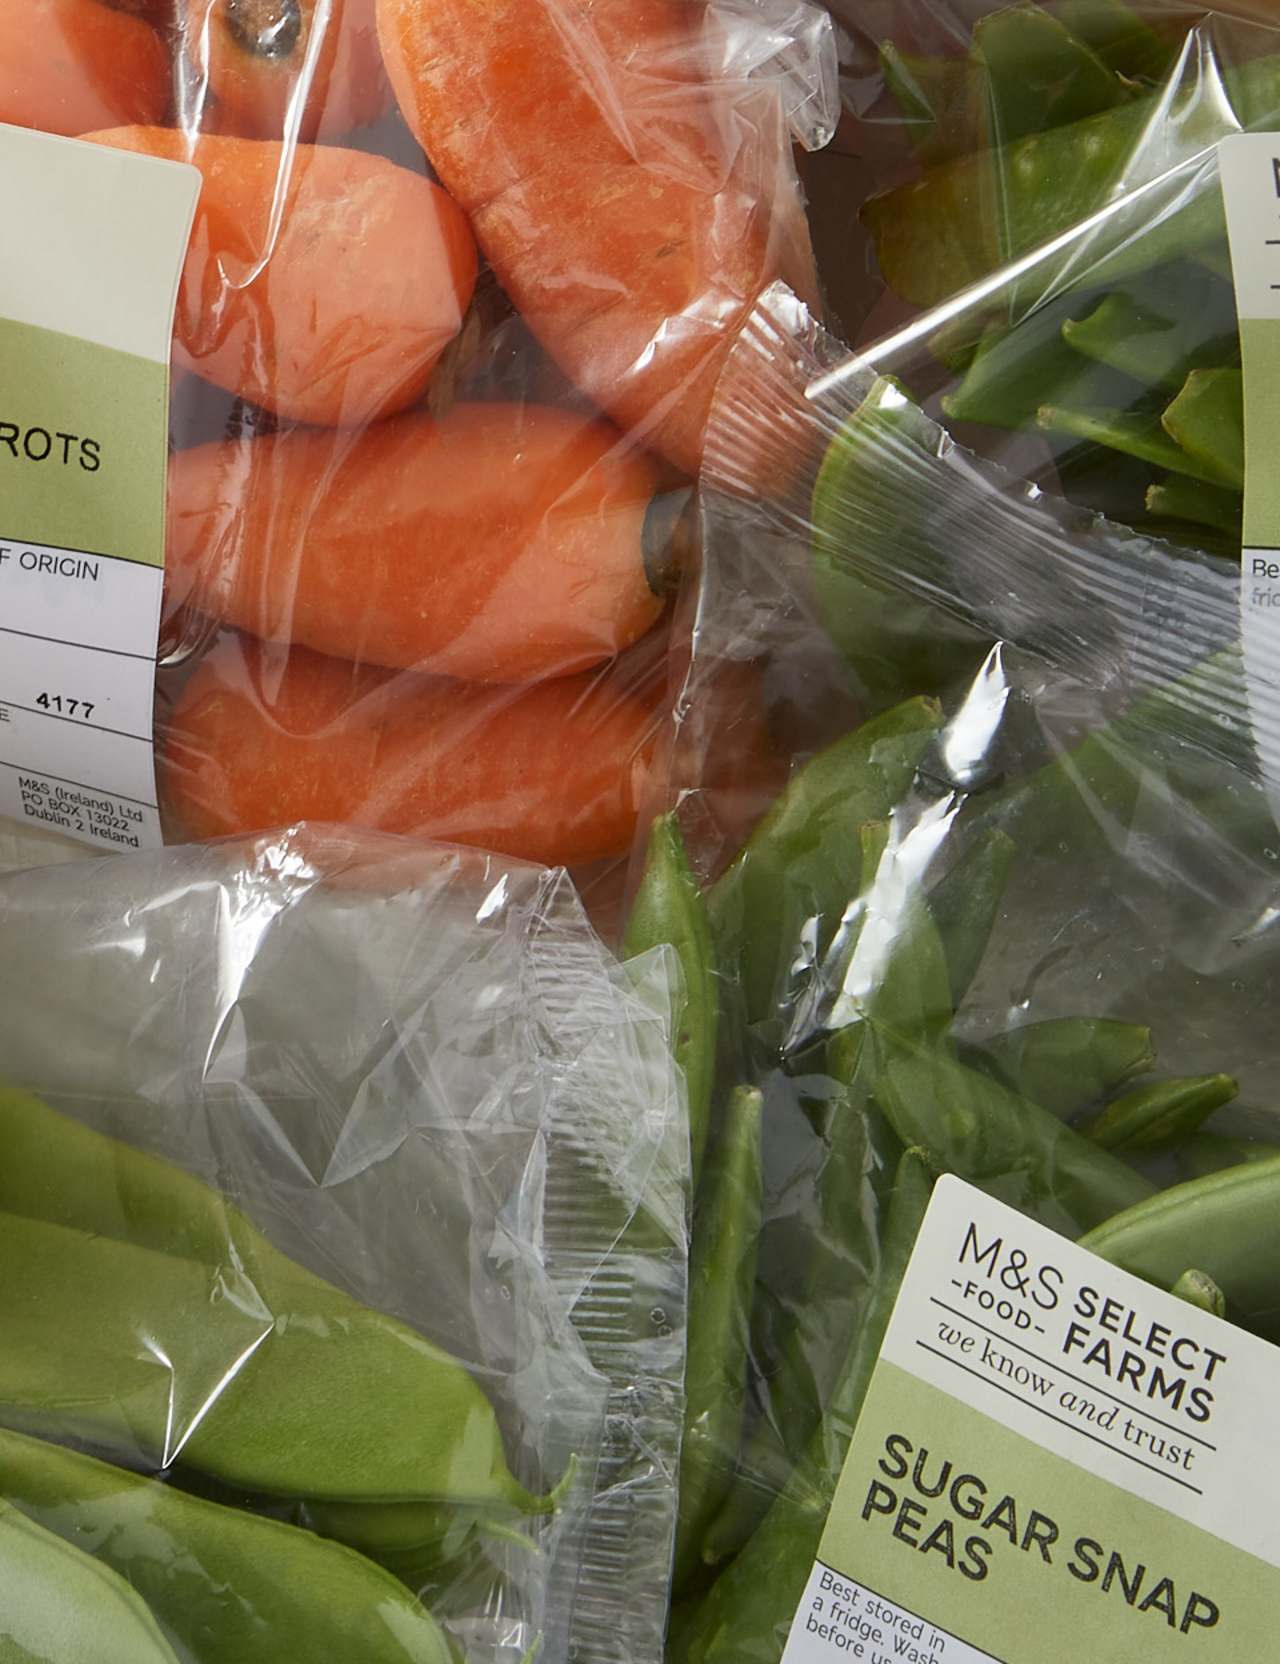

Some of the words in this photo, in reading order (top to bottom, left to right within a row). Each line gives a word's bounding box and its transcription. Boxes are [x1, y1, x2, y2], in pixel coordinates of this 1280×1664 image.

[20, 551, 100, 582] ORIGIN
[36, 692, 95, 719] 4177
[19, 776, 51, 796] M&S
[55, 786, 116, 816] (Ireland)
[120, 805, 144, 823] Ltd
[21, 789, 43, 806] PO
[48, 797, 81, 818] BOX
[86, 809, 131, 832] 13022
[24, 803, 71, 828] Dublin
[76, 819, 86, 832] 2
[90, 824, 140, 848] Ireland
[957, 1222, 1064, 1312] M&S
[1074, 1285, 1227, 1383] SELECT
[937, 1319, 977, 1354] we
[979, 1335, 1056, 1398] know
[1059, 1384, 1121, 1433] and
[1122, 1415, 1196, 1472] trust
[1062, 1321, 1216, 1423] FARMS
[861, 1478, 994, 1582] PEAS
[878, 1432, 1060, 1565] SUGAR
[1067, 1536, 1221, 1635] SNAP
[806, 1613, 865, 1658] before
[812, 1595, 824, 1611] a
[830, 1601, 885, 1646] fridge.
[819, 1571, 860, 1606] Best
[865, 1599, 925, 1639] stored
[929, 1629, 946, 1654] in
